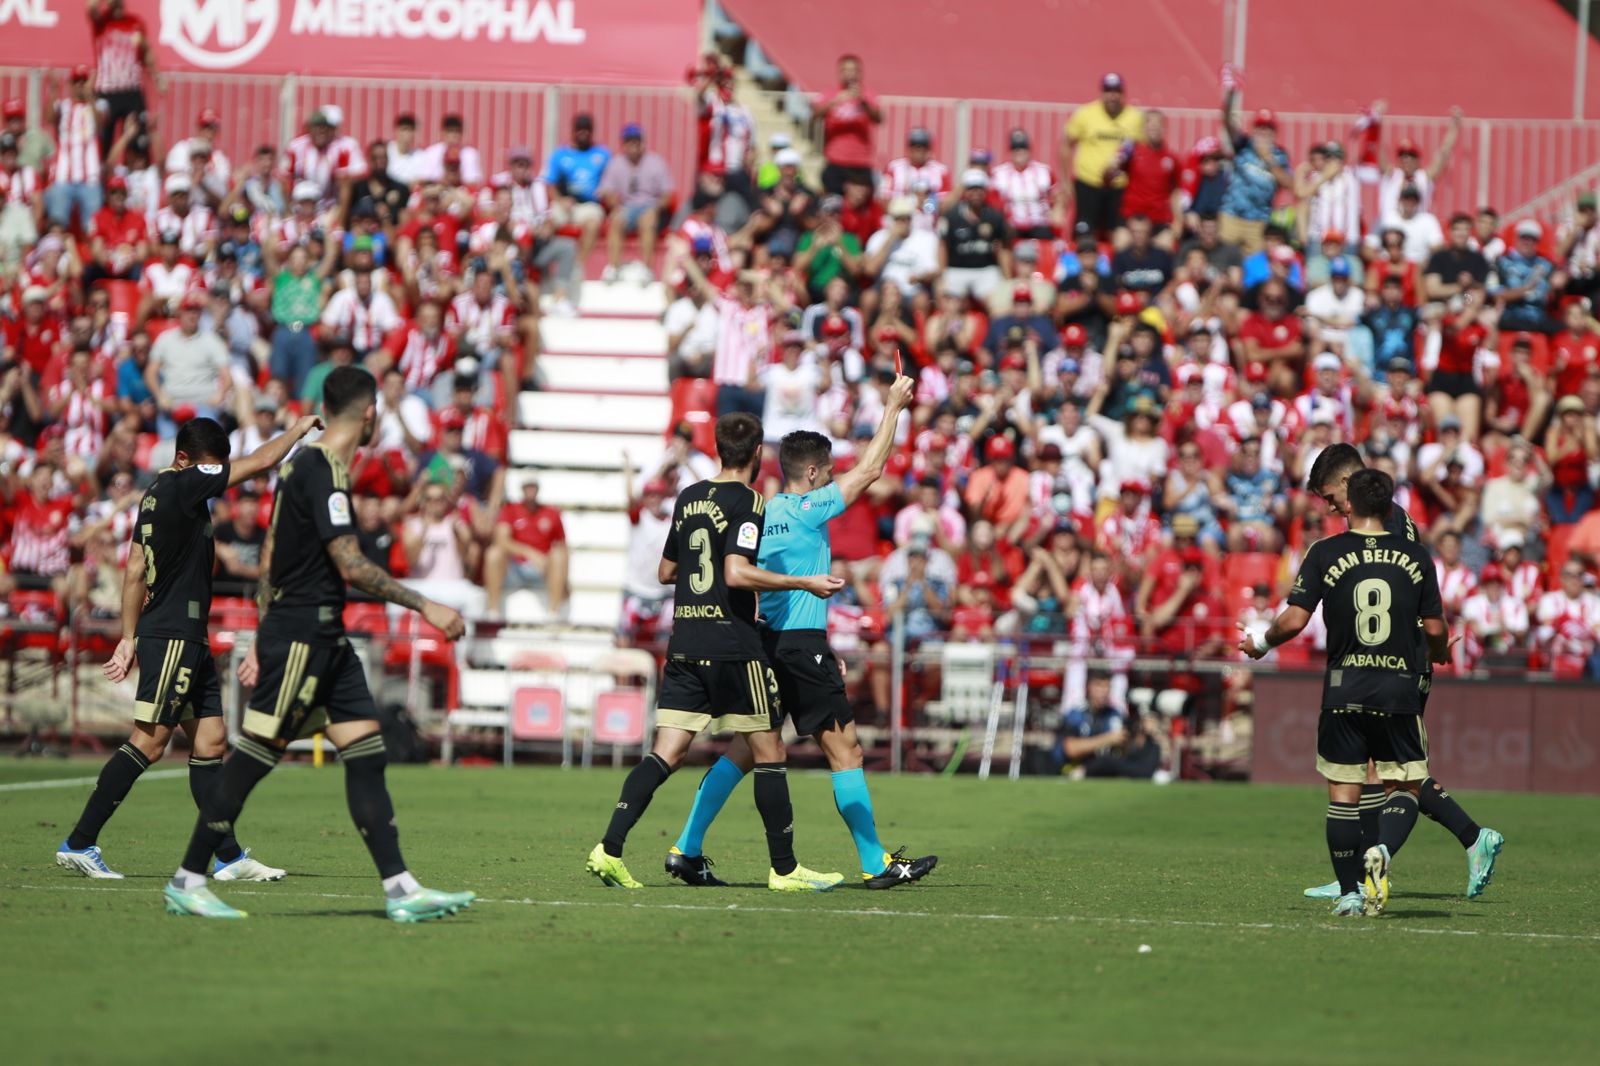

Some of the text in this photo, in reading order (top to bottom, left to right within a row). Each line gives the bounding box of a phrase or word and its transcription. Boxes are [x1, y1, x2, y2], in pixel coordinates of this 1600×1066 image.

[291, 0, 585, 43] MERCOPHAL
[689, 527, 714, 595] 3
[1324, 549, 1424, 588] FRAN BELTRÁN
[1353, 578, 1392, 646] 8
[1345, 653, 1408, 670] ABANCA
[175, 667, 192, 694] 5
[298, 676, 318, 702] 4
[766, 667, 779, 694] 3
[1382, 807, 1406, 815] 1923
